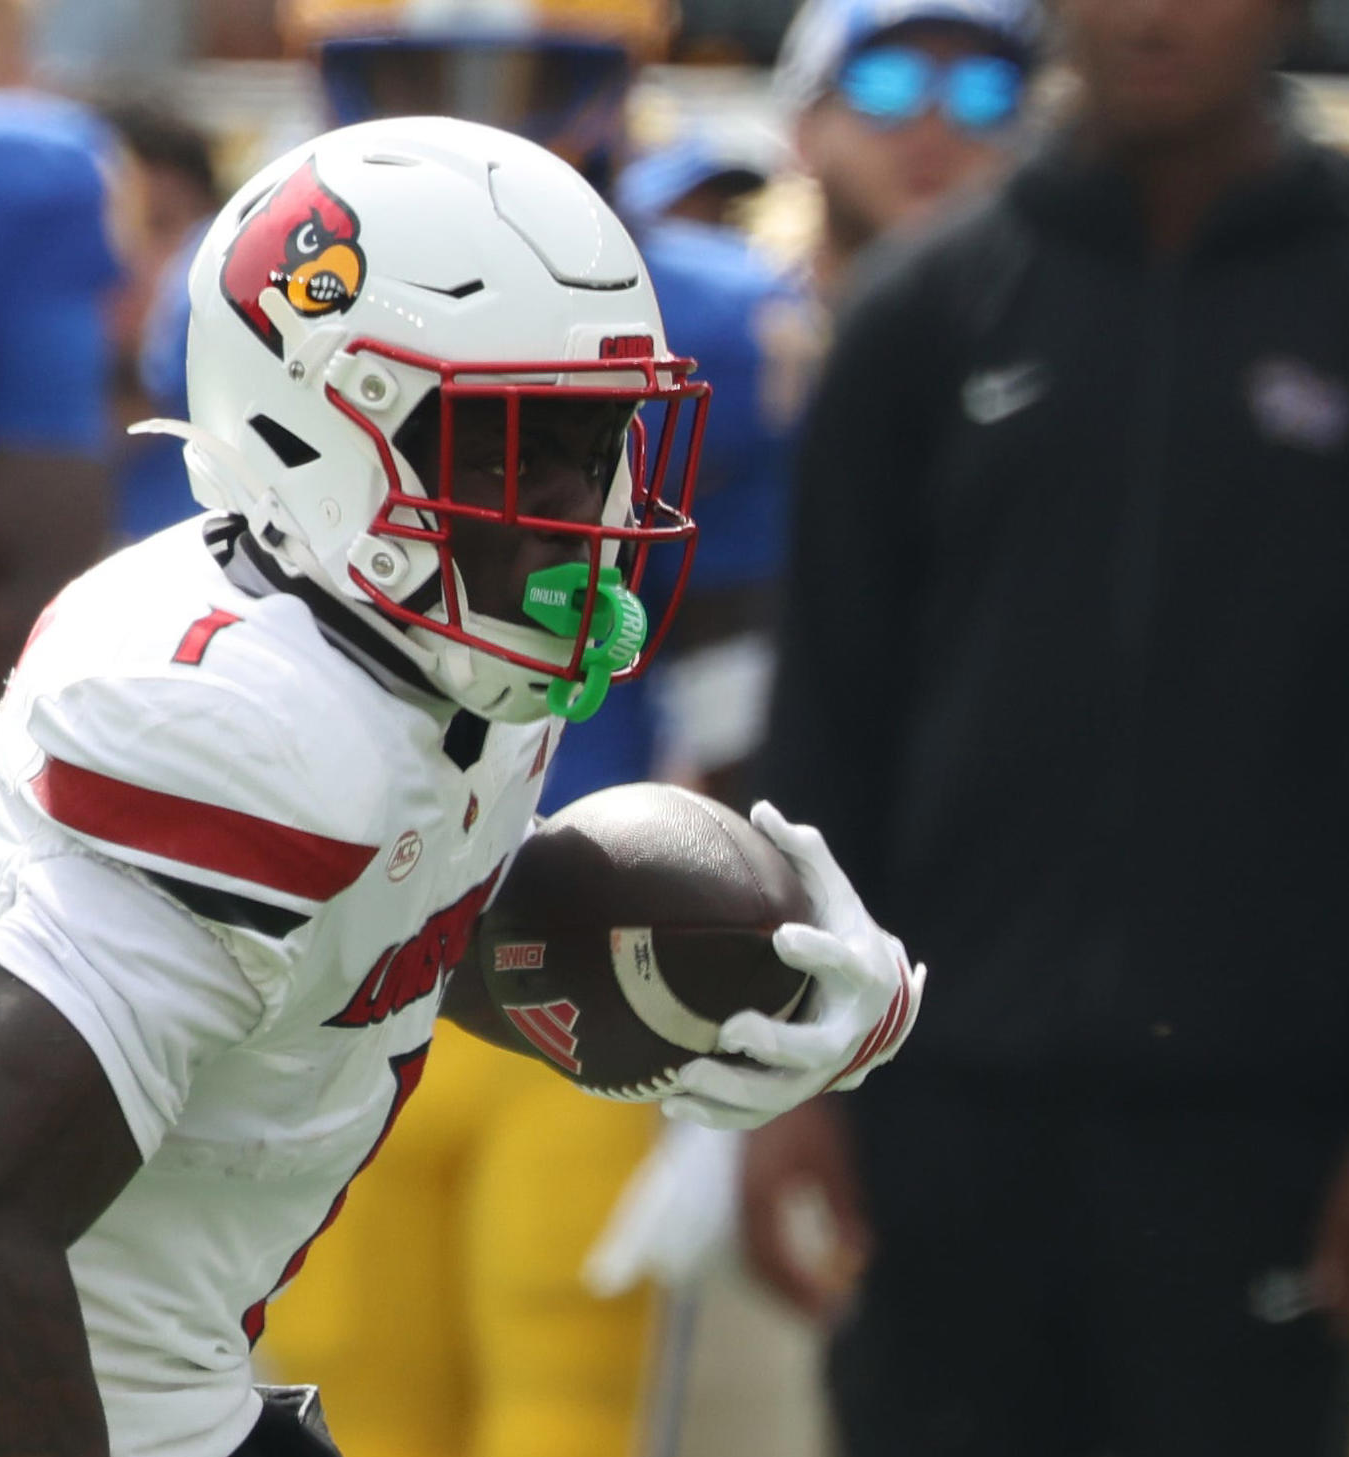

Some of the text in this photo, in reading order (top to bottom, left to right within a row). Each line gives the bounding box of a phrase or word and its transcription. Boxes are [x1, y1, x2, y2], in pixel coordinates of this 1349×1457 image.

[529, 586, 568, 607] NXTRND
[170, 603, 245, 666] 1
[494, 943, 547, 972] DIME
